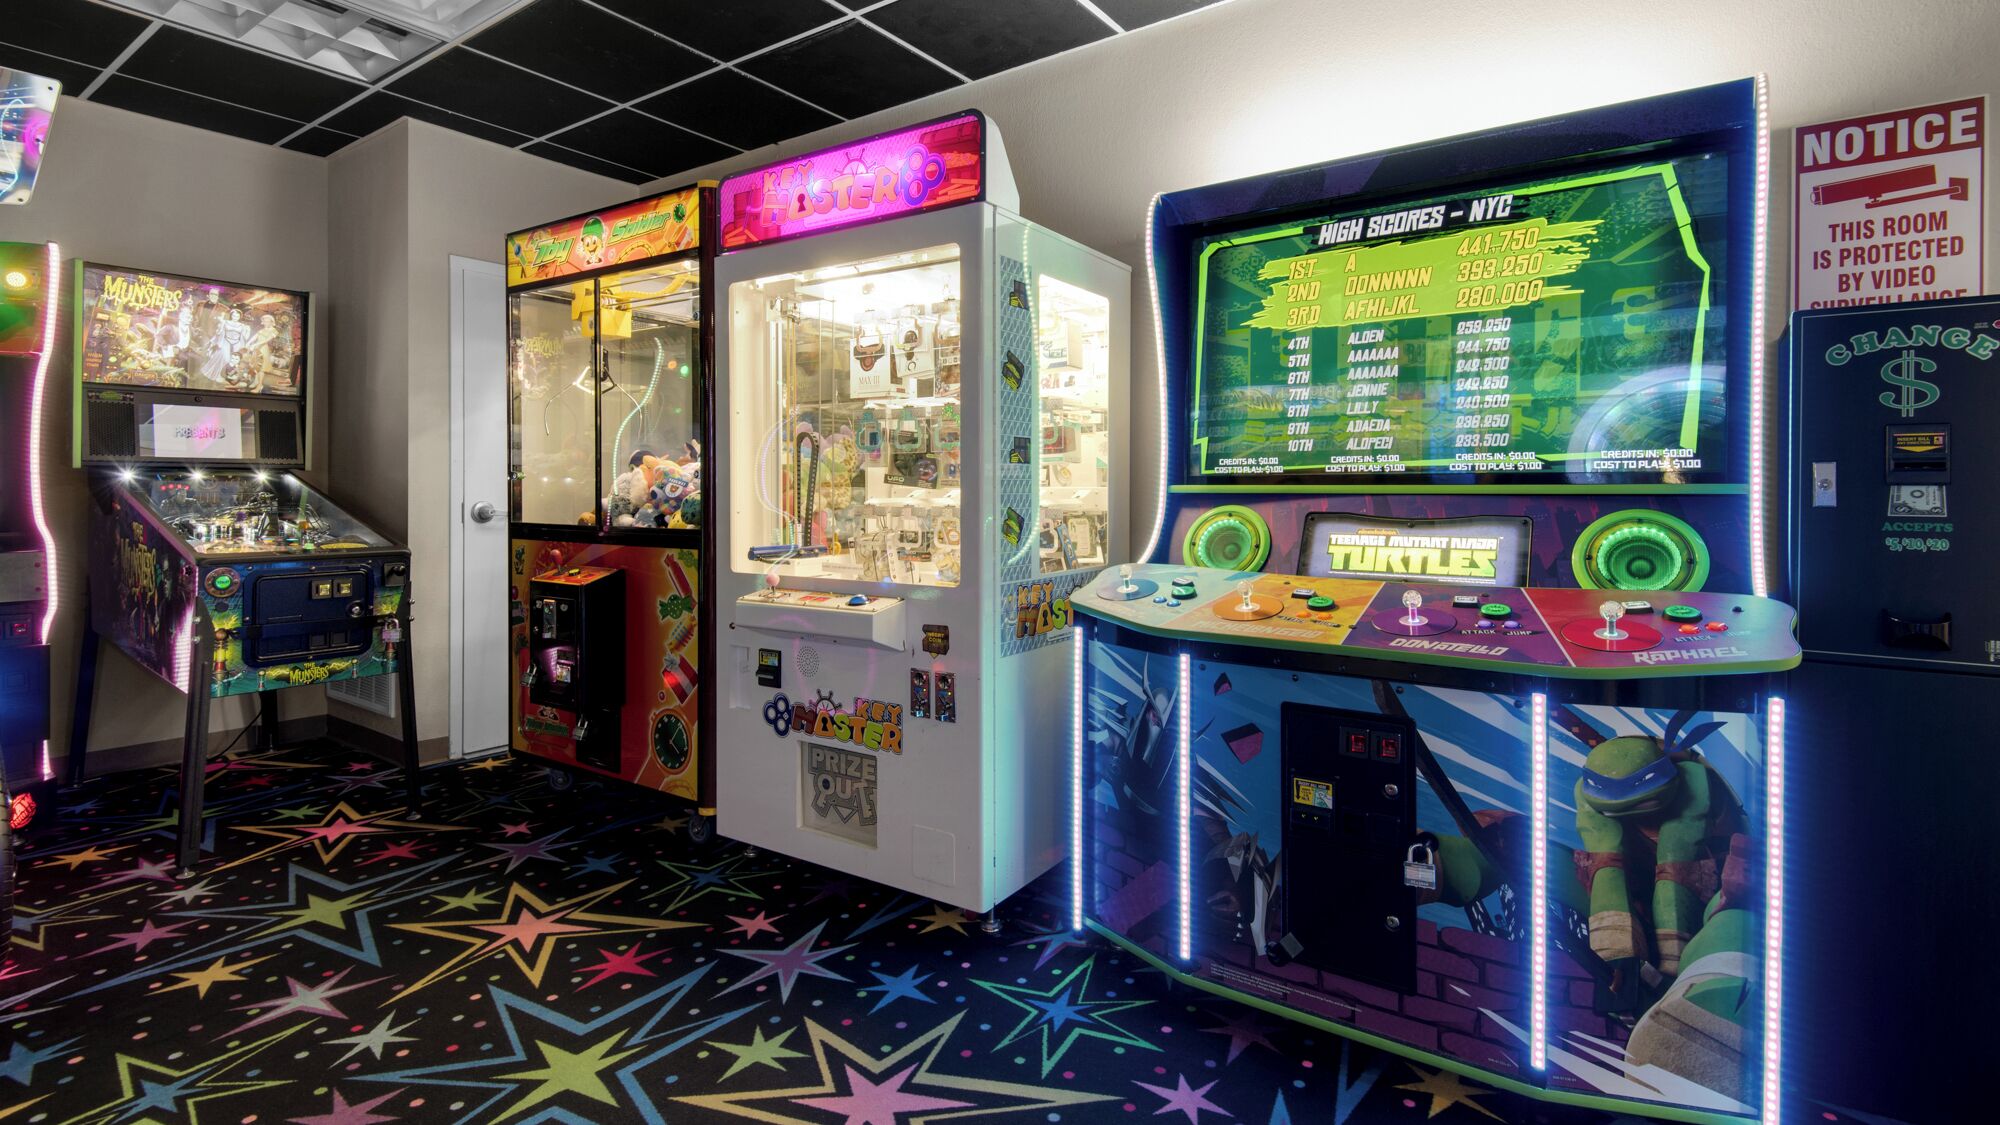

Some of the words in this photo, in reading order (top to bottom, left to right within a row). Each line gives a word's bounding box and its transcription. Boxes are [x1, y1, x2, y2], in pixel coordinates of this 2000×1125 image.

[1803, 106, 1977, 167] NOTICE
[763, 160, 814, 193] KEY
[762, 166, 898, 227] MASTER
[1318, 218, 1364, 245] HIGH
[1366, 205, 1446, 239] SCORES
[1469, 194, 1514, 222] NYC
[1829, 219, 1875, 243] THIS
[1883, 210, 1948, 237] ROOM
[533, 237, 575, 267] Toy
[608, 212, 671, 245] Soldier
[1813, 249, 1831, 270] IS
[1839, 235, 1964, 267] PROTECTED
[1289, 259, 1318, 280] 1ST
[1344, 253, 1356, 273] A
[1456, 227, 1540, 257] 441,750
[1286, 281, 1321, 303] 2ND
[1456, 252, 1543, 282] 393,250
[1838, 272, 1865, 293] BY
[1871, 265, 1935, 290] VIDEO
[103, 275, 183, 312] MUNSTERS
[1286, 305, 1321, 326] 3RD
[1344, 294, 1420, 320] AFHIJKL
[1456, 280, 1543, 308] 280,000
[1288, 336, 1310, 350] 4TH
[1825, 324, 1999, 366] CHANGE
[1288, 354, 1310, 367] 5TH
[1289, 387, 1310, 401] 7TH
[1346, 382, 1390, 398] JENNIE
[1288, 404, 1310, 417] 8TH
[1346, 401, 1379, 415] LILLY
[1288, 439, 1314, 452] 10TH
[1456, 452, 1493, 461] CREDITS
[1493, 452, 1506, 460] IN:
[1509, 451, 1536, 460] $0.00
[1601, 450, 1644, 459] CREDITS
[1645, 449, 1660, 458] IN:
[1662, 448, 1694, 458] $0.00
[1325, 465, 1346, 473] COST
[1359, 464, 1382, 473] PLAY:
[1384, 463, 1405, 472] $1.00
[1331, 455, 1363, 464] CREDITS
[1364, 455, 1375, 463] IN:
[1377, 454, 1399, 463] $0.00
[1449, 462, 1473, 471] COST
[1474, 462, 1486, 470] TO
[1487, 462, 1515, 471] PLAY:
[1518, 461, 1543, 470] $1.00
[1594, 460, 1622, 469] COST
[1623, 460, 1637, 469] TO
[1638, 459, 1670, 469] PLAY:
[1672, 459, 1701, 468] $1.00
[1882, 522, 1954, 533] ACCEPTS
[1330, 534, 1386, 546] TEENAGE
[1389, 536, 1449, 548] MUTANT
[1450, 537, 1498, 550] NINJA
[1328, 545, 1498, 578] TURTLES
[1018, 582, 1054, 605] KEY
[1016, 597, 1074, 639] MAST
[1389, 638, 1510, 656] DONATELLO
[1632, 646, 1749, 664] RAPHAEL
[290, 666, 329, 685] MUNSTERS
[856, 699, 902, 724] KEY
[791, 703, 902, 754] MASTER
[812, 747, 876, 780] PRIZE
[815, 773, 876, 818] OUT
